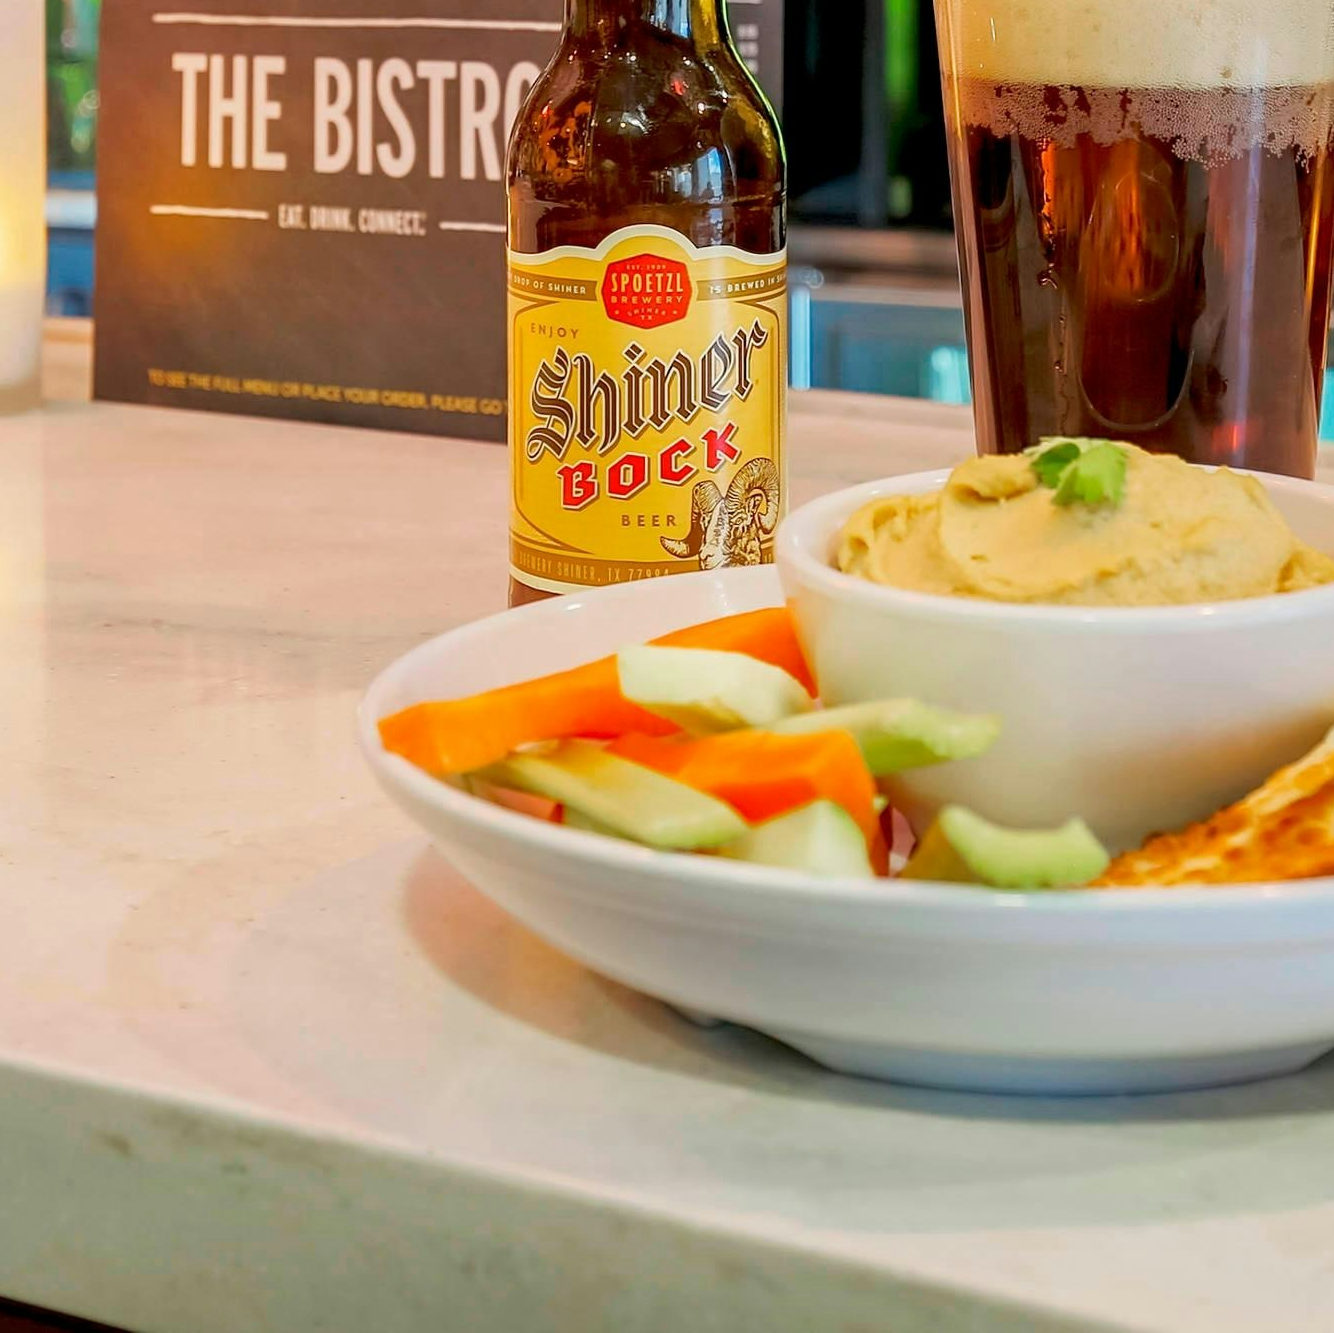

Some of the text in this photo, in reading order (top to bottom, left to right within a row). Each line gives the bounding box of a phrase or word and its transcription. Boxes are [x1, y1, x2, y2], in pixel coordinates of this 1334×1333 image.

[172, 53, 287, 171] THE
[278, 204, 307, 229] EAT.
[533, 280, 544, 289] OF
[548, 283, 586, 295] SHINER
[611, 272, 683, 293] SPOETZL
[727, 279, 765, 293] BREWED
[611, 295, 683, 304] BREWERY
[530, 323, 579, 339] ENJOY
[526, 317, 769, 462] Shiner
[479, 398, 503, 415] GO
[557, 421, 741, 510] BOCK
[621, 514, 677, 527] BEER
